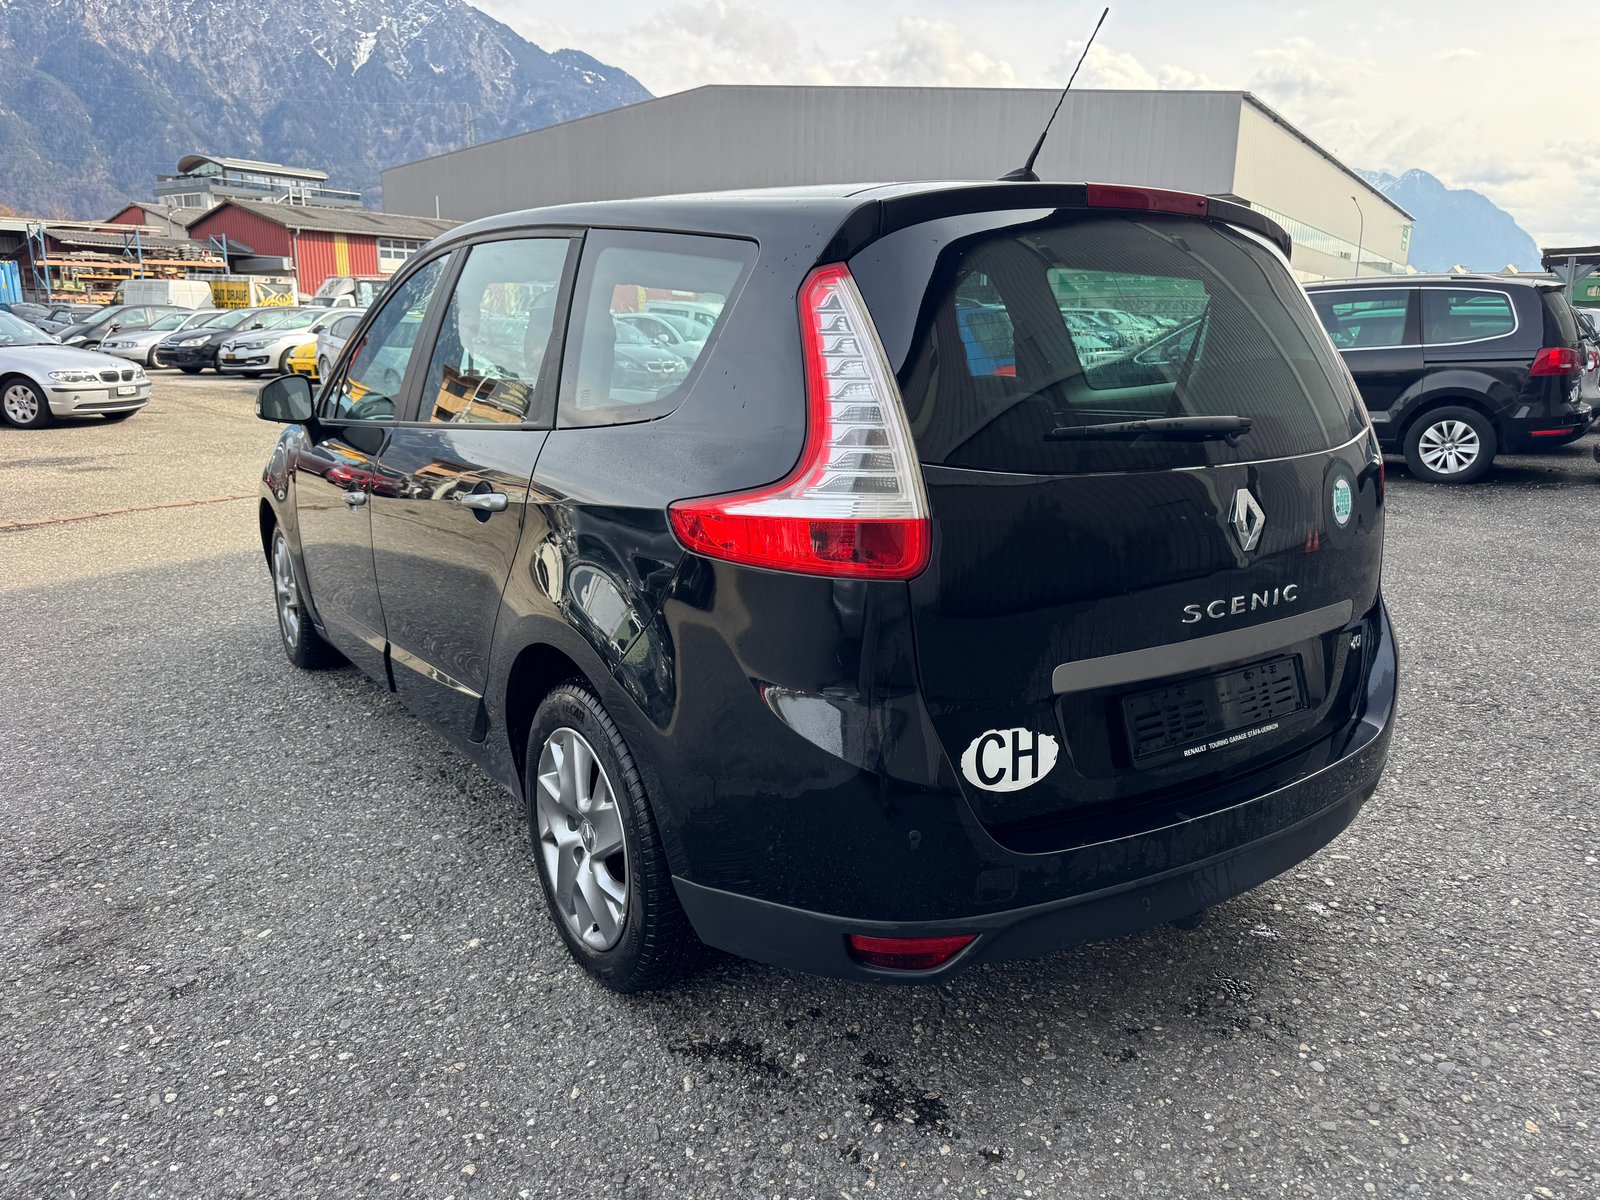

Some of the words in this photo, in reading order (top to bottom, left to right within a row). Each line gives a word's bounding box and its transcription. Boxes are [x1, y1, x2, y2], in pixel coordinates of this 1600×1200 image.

[227, 289, 247, 301] DRAUF
[1182, 584, 1298, 624] SCENIC
[975, 731, 1039, 786] CH
[1183, 744, 1207, 757] RENAULT
[1208, 738, 1229, 749] TOURING
[1229, 733, 1247, 743] GARAGE
